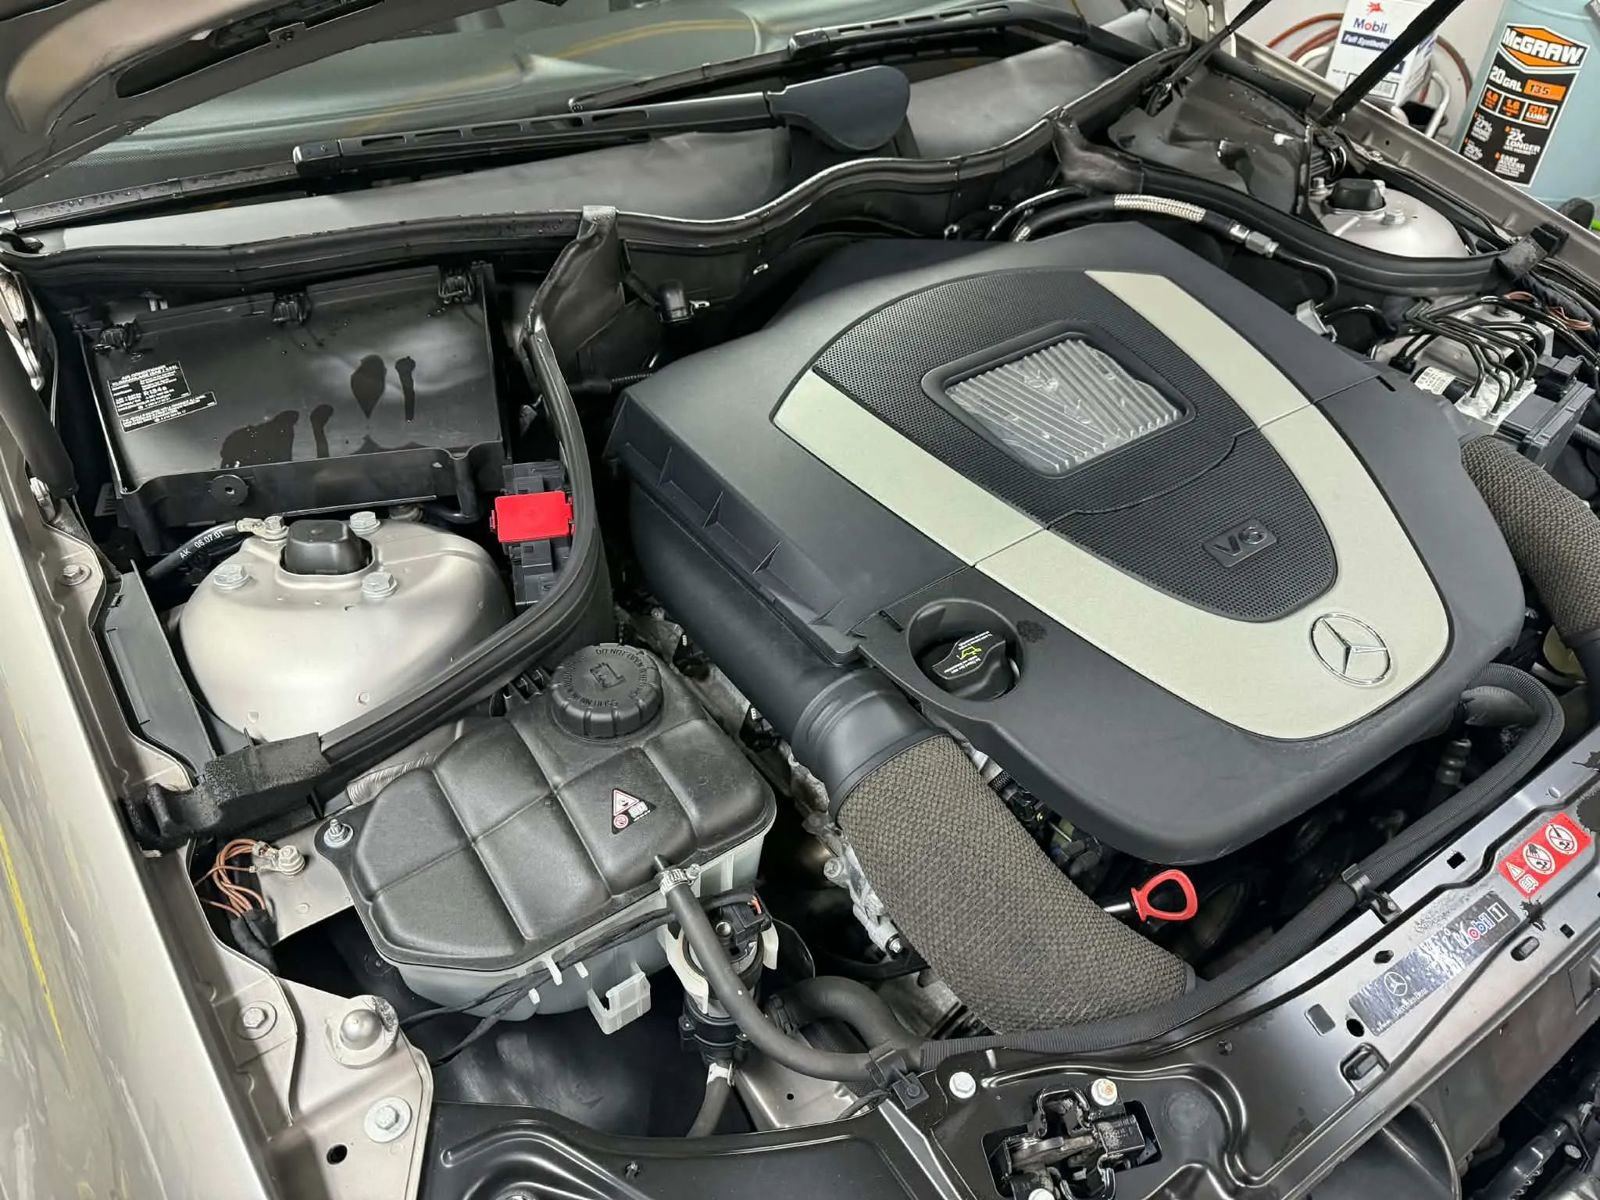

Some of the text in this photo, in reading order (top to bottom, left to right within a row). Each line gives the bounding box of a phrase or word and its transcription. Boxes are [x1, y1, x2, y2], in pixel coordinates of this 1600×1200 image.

[1353, 18, 1388, 33] Mobil
[1502, 28, 1584, 65] McGRAW
[180, 548, 192, 560] AK
[1211, 525, 1268, 557] V6
[1453, 912, 1495, 949] Mobil
